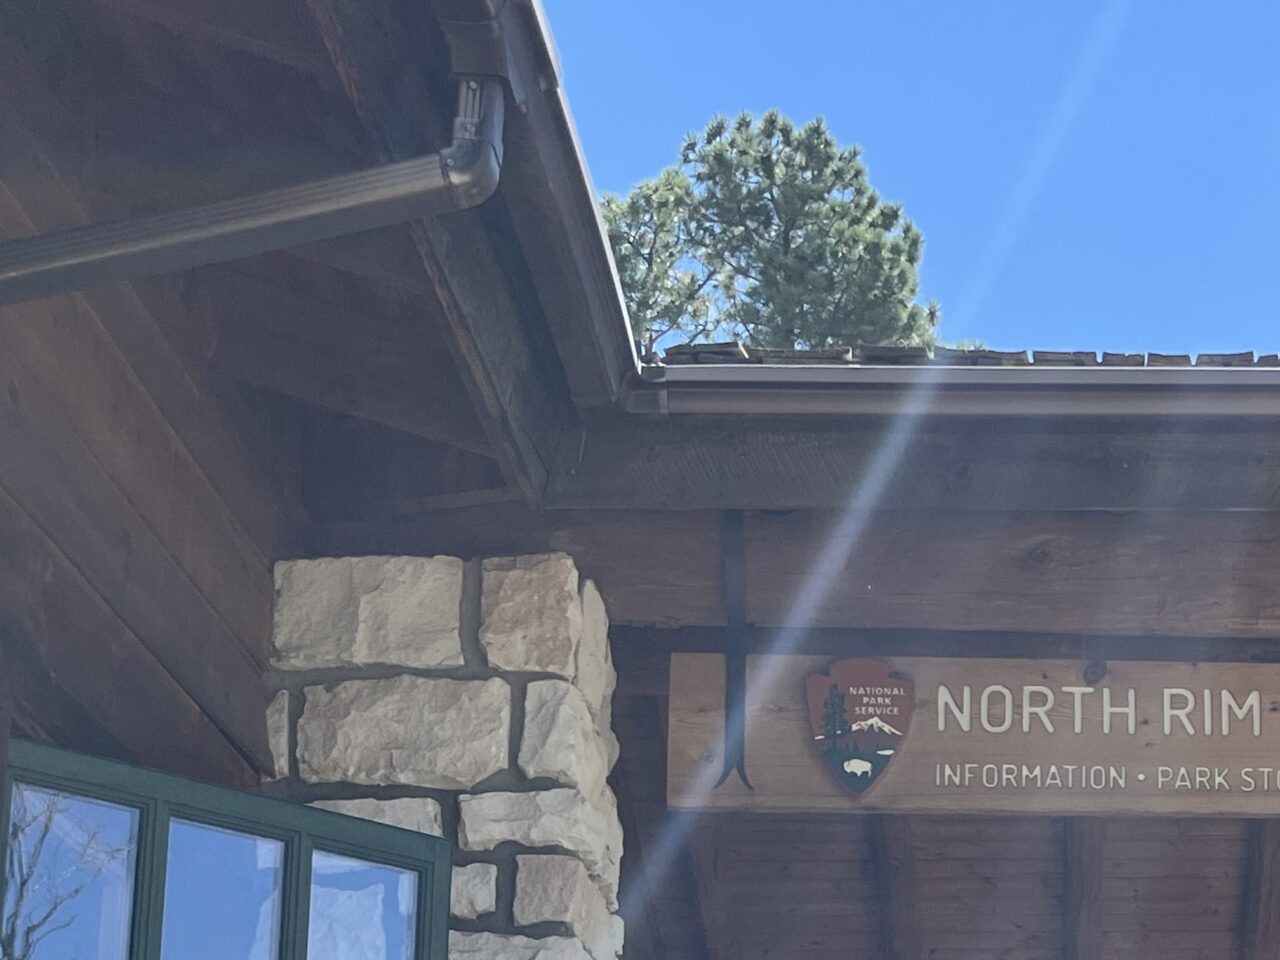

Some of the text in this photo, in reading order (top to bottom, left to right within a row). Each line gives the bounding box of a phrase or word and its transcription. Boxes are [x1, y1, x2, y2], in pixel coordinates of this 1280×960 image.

[849, 686, 906, 696] NATIONAL
[862, 697, 892, 705] PARK
[854, 706, 899, 715] SERVICE
[937, 685, 1136, 735] NORTH
[1163, 688, 1261, 737] RIM
[936, 763, 1126, 789] INFORMATION
[1157, 766, 1230, 790] PARK
